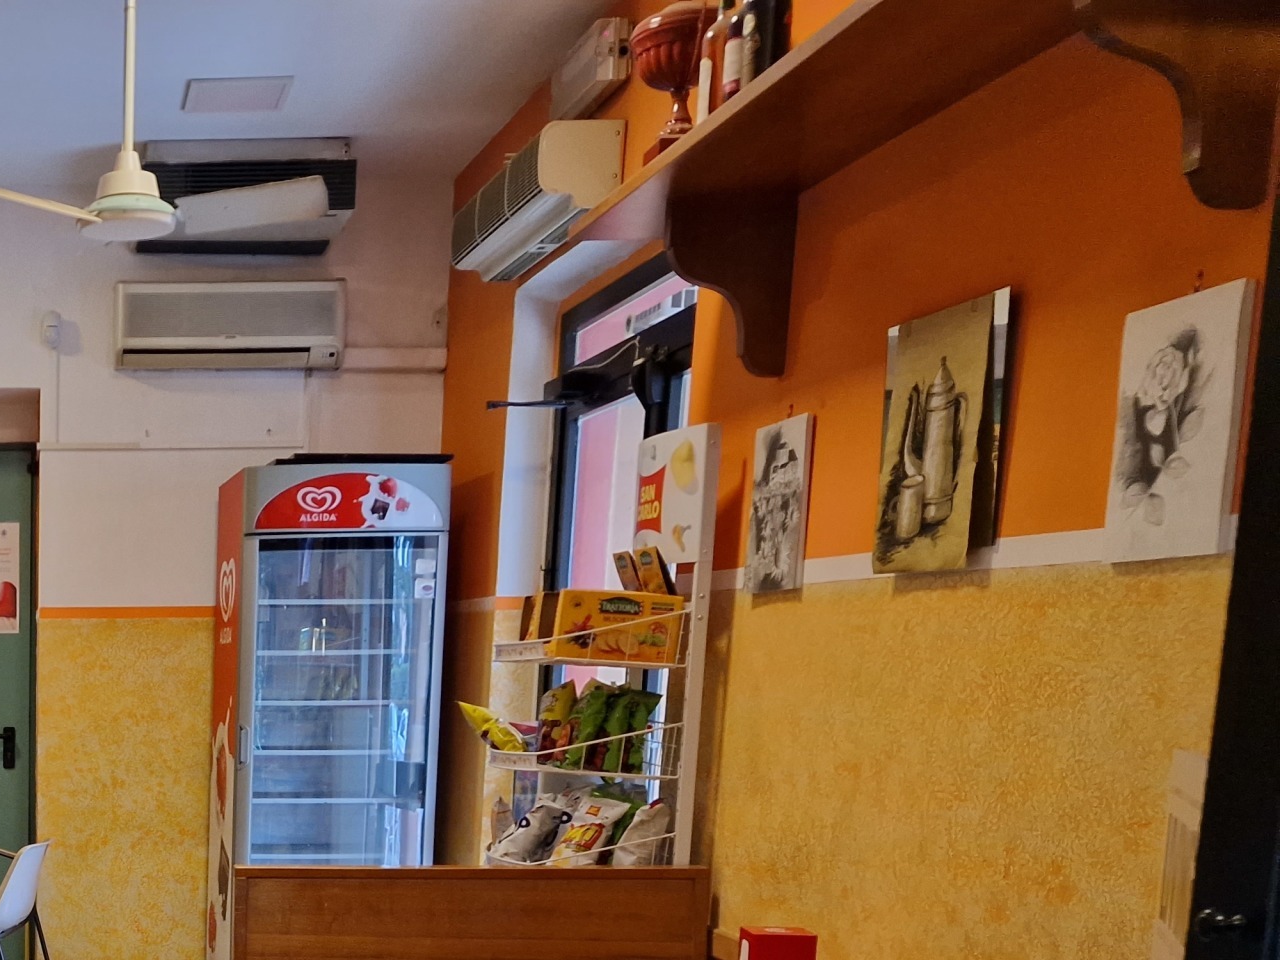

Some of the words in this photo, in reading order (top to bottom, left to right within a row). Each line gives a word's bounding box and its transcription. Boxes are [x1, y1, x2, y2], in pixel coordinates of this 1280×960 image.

[640, 483, 656, 503] SAN
[299, 513, 337, 522] ALGIDA
[637, 501, 660, 521] CARLO
[601, 602, 639, 613] TRATTORIA
